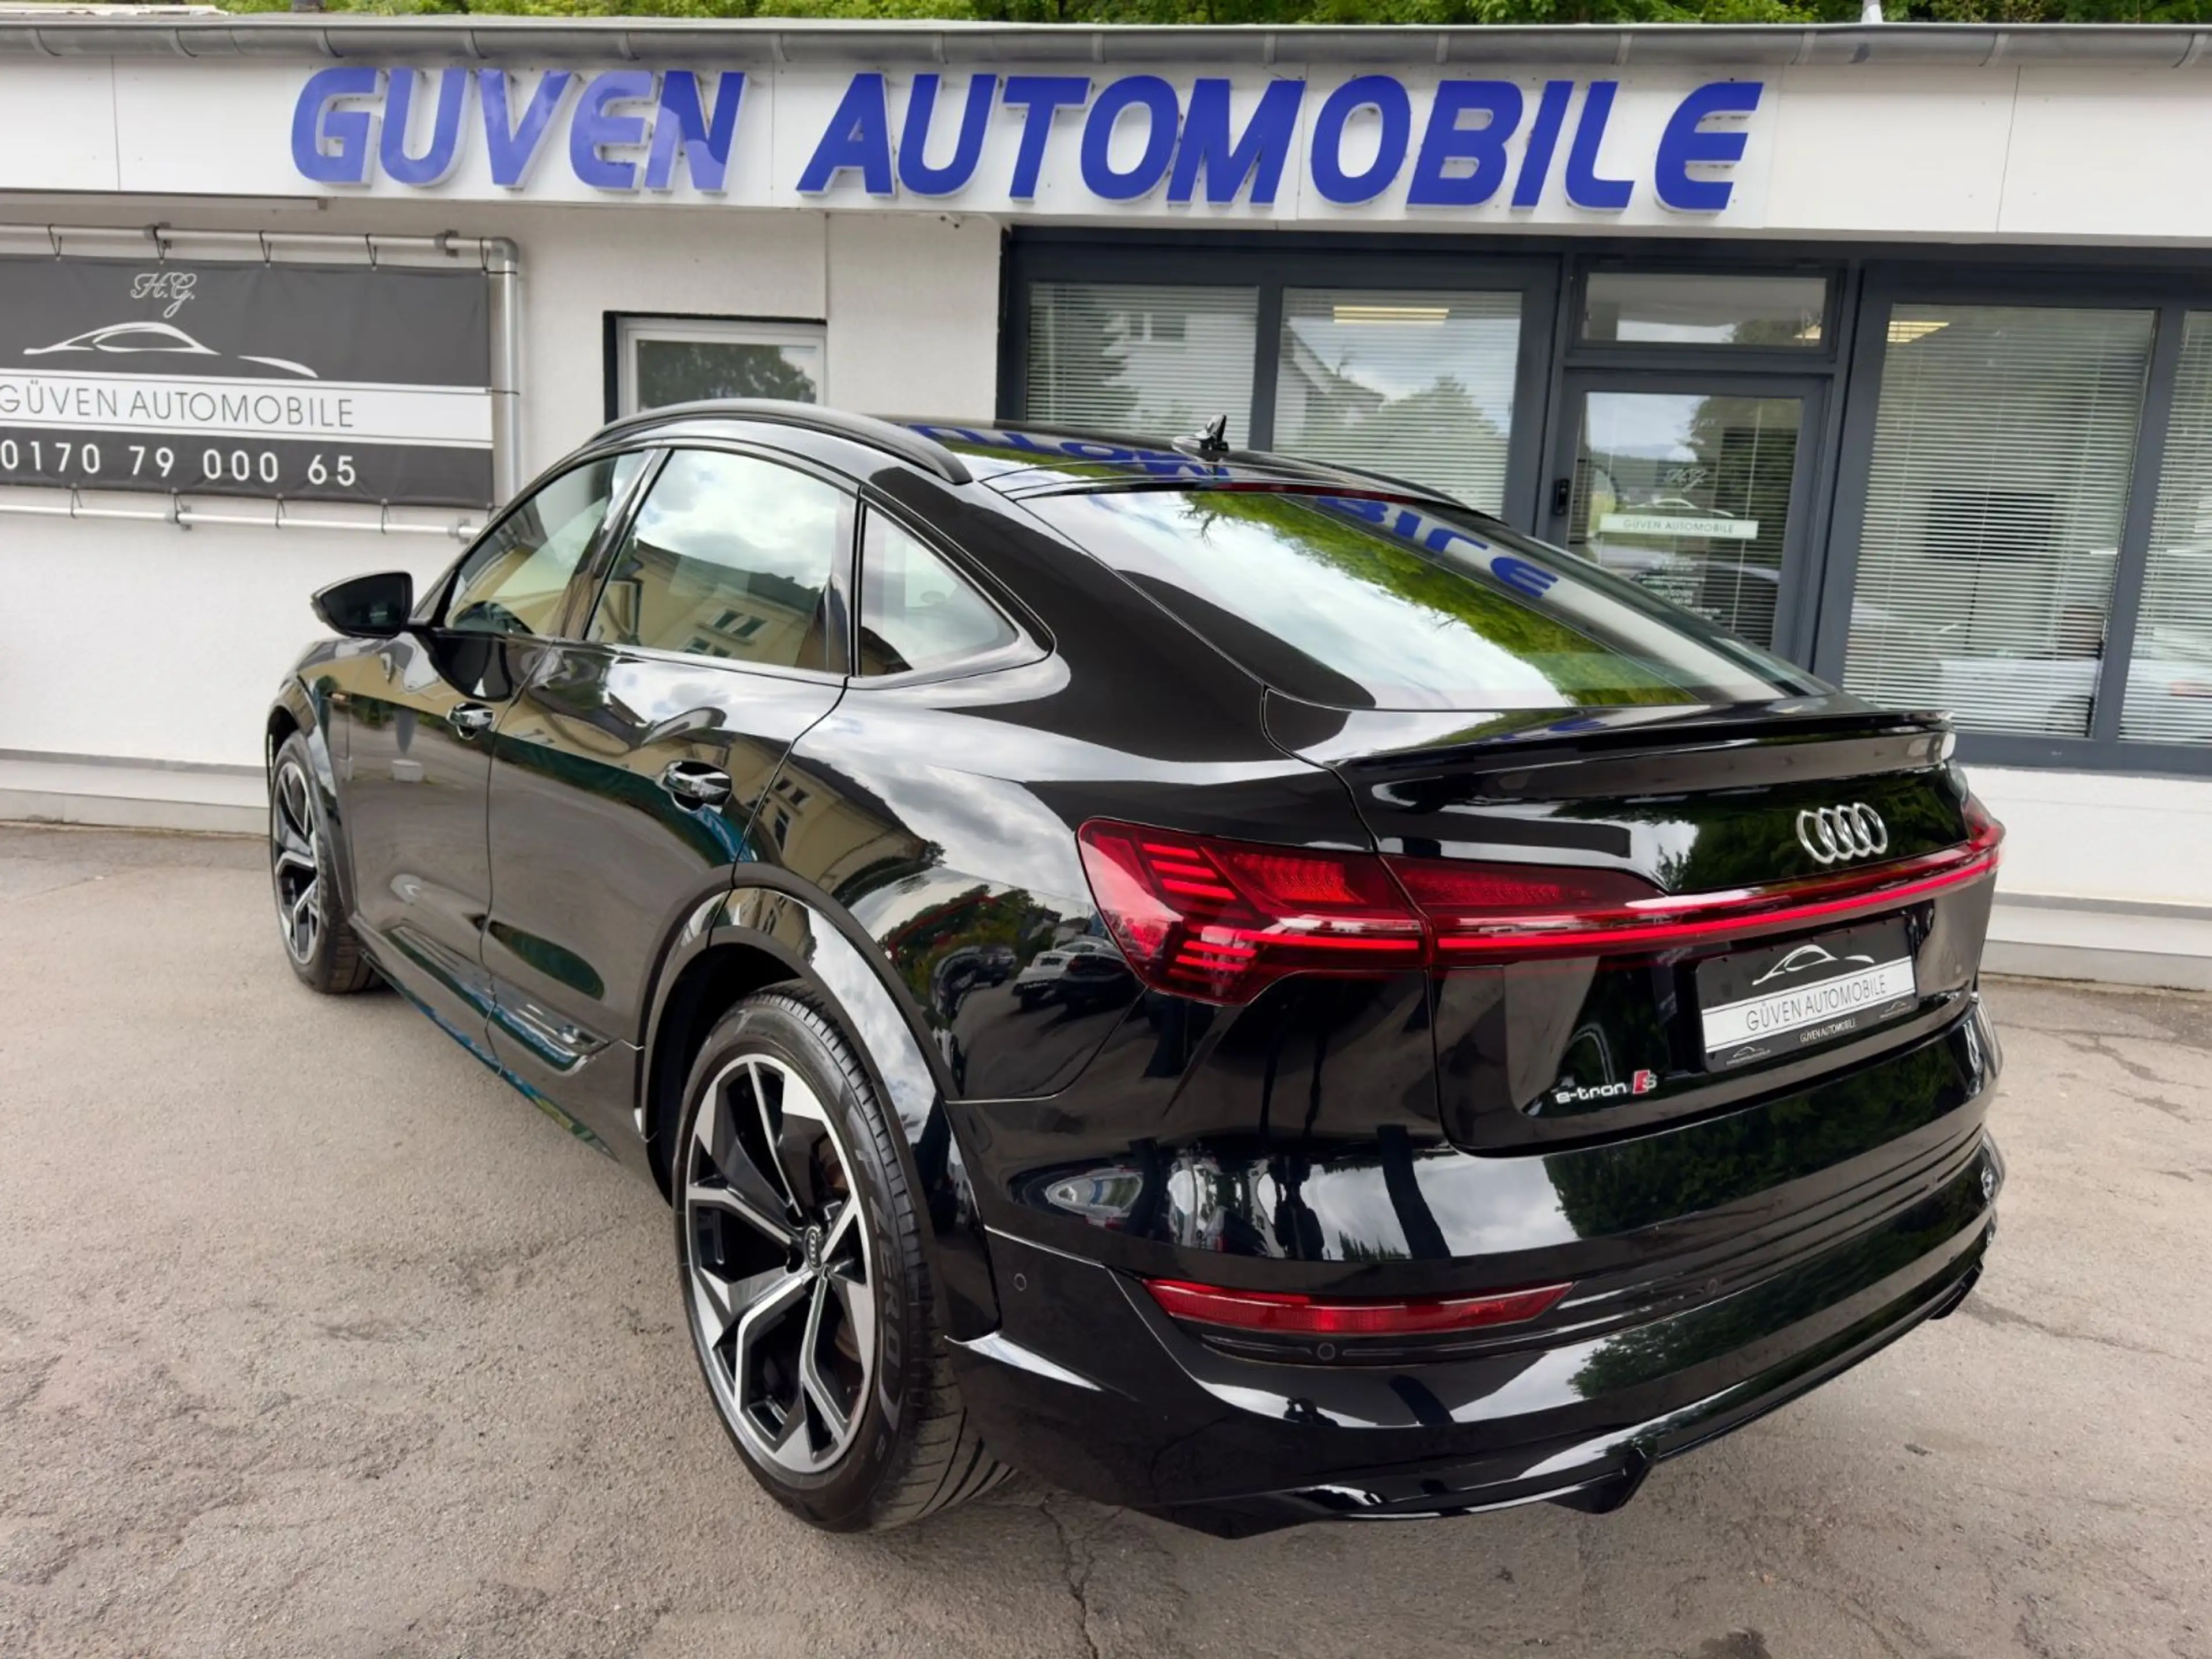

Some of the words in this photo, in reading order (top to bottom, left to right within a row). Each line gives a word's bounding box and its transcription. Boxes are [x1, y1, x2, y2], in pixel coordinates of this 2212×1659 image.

[291, 66, 747, 192] GUVEN
[796, 73, 1764, 211] AUTOMOBILE
[0, 379, 117, 417] GÜVEN
[130, 391, 353, 427] AUTOMOBILE
[0, 439, 100, 474] 0170
[128, 445, 175, 478] 79
[203, 448, 279, 483] 000
[308, 454, 355, 486] 65
[1665, 521, 1734, 534] AUTOMOBILE
[1746, 998, 1802, 1031] GÜVEN
[1805, 975, 1886, 1016] AUTOMOBILE
[1555, 1082, 1627, 1104] e-tron
